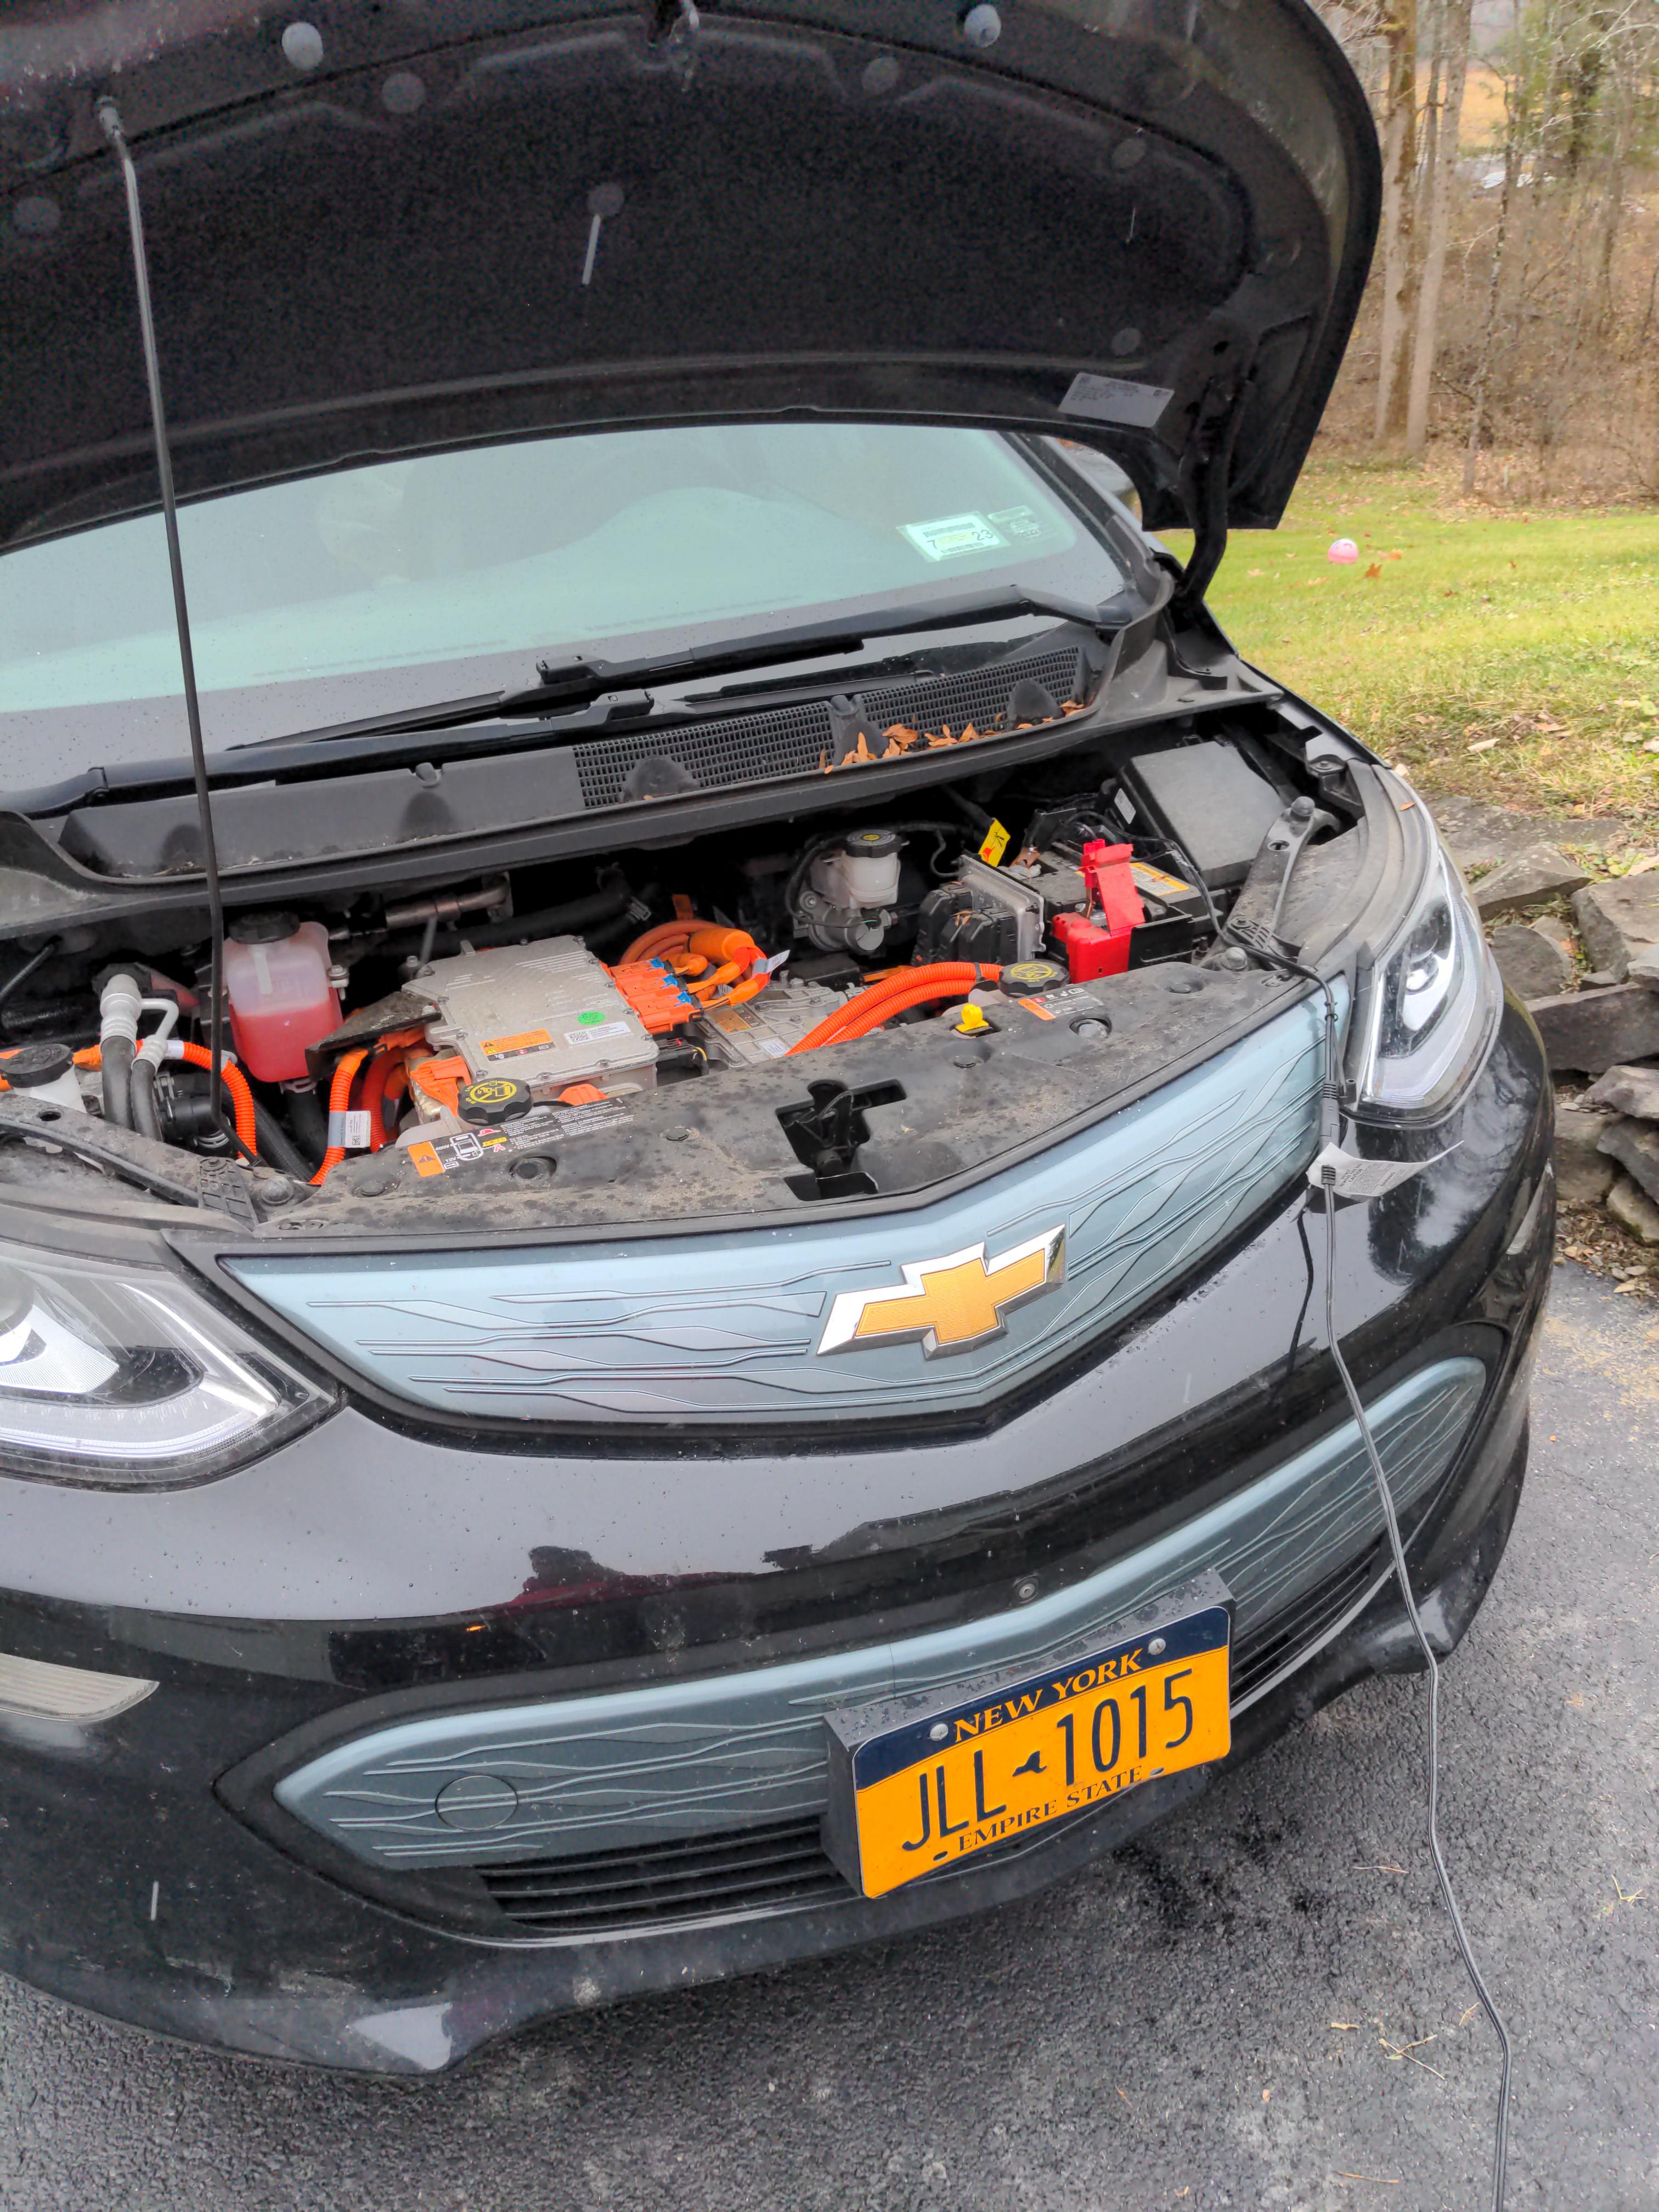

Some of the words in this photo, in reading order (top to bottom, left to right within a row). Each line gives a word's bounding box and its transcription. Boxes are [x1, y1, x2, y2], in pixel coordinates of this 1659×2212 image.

[972, 529, 994, 541] 23
[1348, 1168, 1362, 1183] CAUTION
[953, 1689, 1043, 1743] NEW
[1051, 1649, 1146, 1699] YORK
[901, 1749, 1007, 1852] JLL
[1057, 1668, 1193, 1787] 1015
[958, 1798, 1058, 1852] EMPIRE
[1066, 1765, 1143, 1808] STATE
